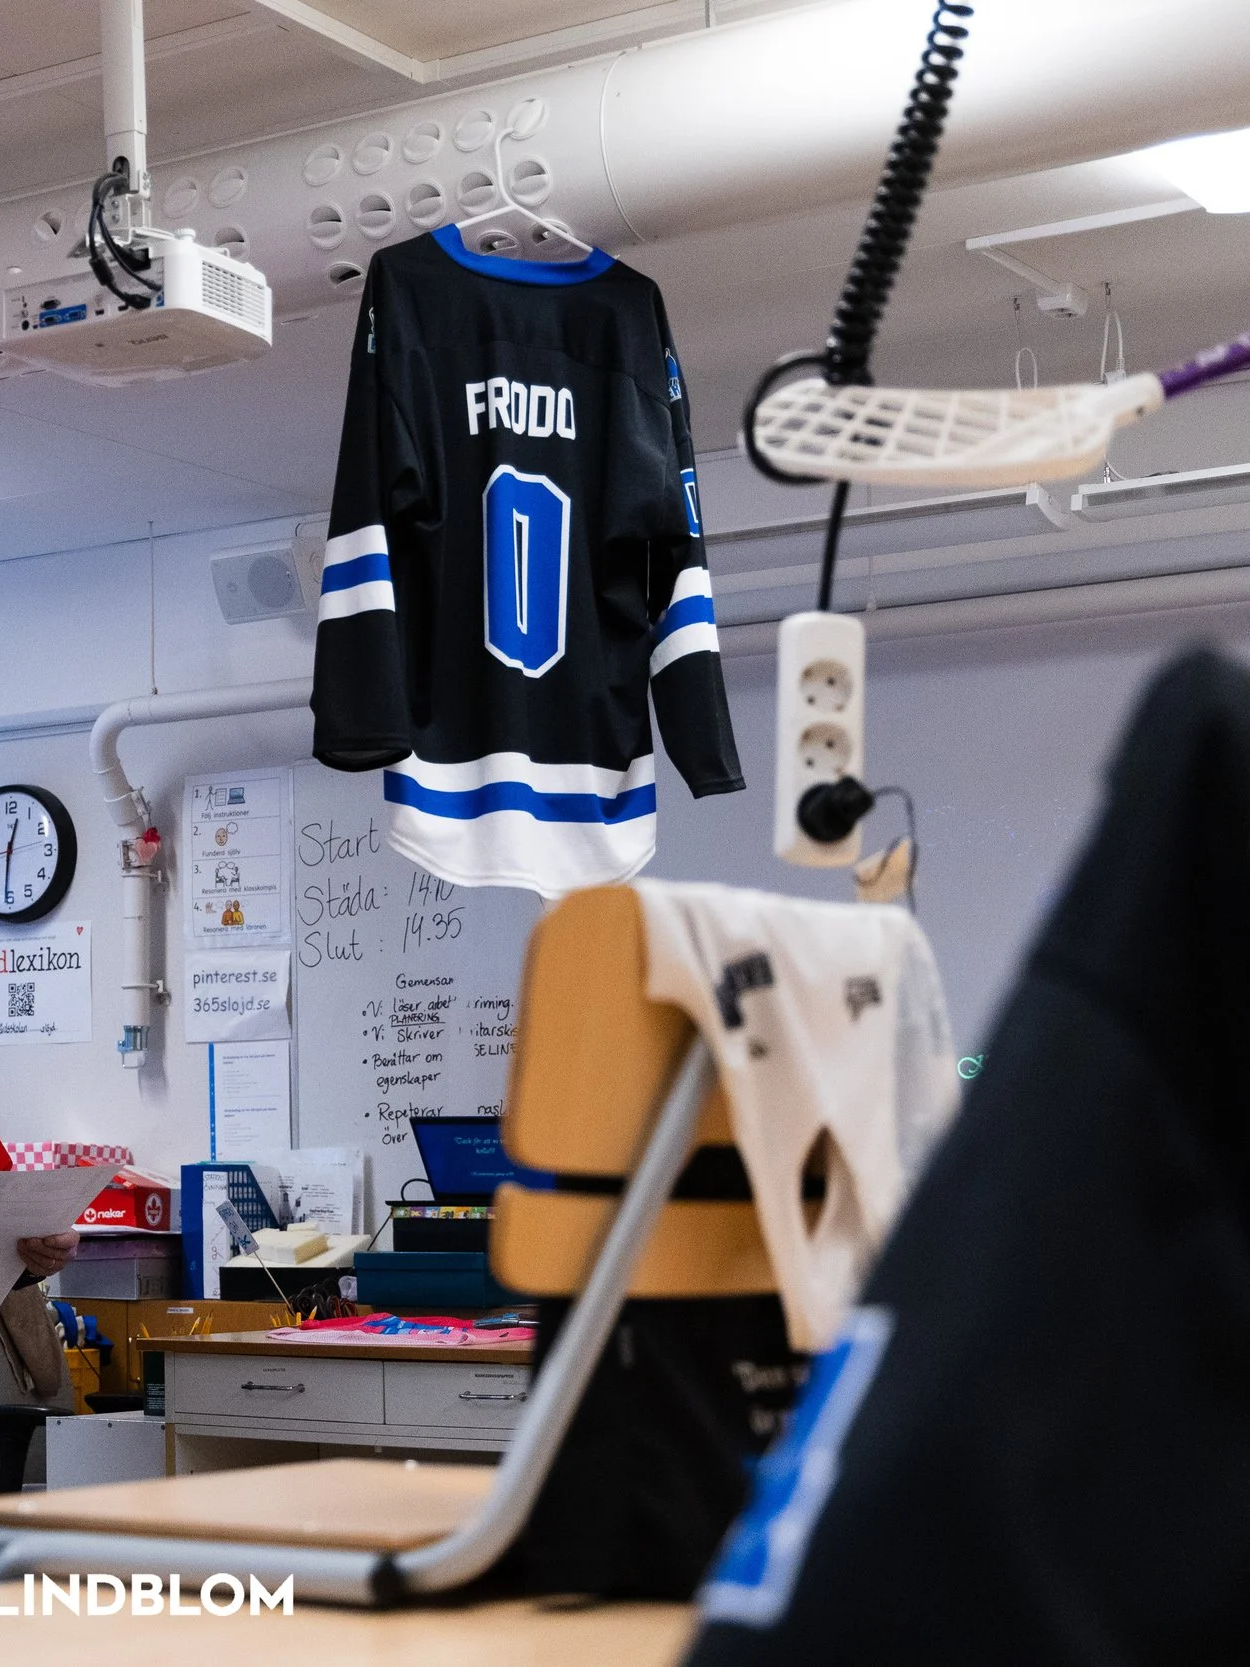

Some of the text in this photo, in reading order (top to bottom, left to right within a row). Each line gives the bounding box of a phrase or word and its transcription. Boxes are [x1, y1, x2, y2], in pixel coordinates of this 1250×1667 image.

[465, 376, 576, 441] FRODO
[482, 464, 571, 680] 0
[5, 801, 18, 815] 12
[193, 826, 202, 836] 2.
[44, 843, 53, 857] 3
[298, 817, 381, 867] Start
[37, 867, 46, 880] 4
[194, 865, 202, 874] 3.
[6, 890, 15, 904] 6
[24, 884, 33, 898] 5
[193, 902, 202, 912] 4.
[298, 928, 364, 968] Slut
[402, 906, 466, 954] 14.35
[193, 970, 278, 989] pinterest.se
[193, 996, 271, 1016] 365slojd.se
[371, 1049, 443, 1070] Berättar om
[376, 1071, 441, 1095] egenskaper
[381, 1126, 408, 1145] Över
